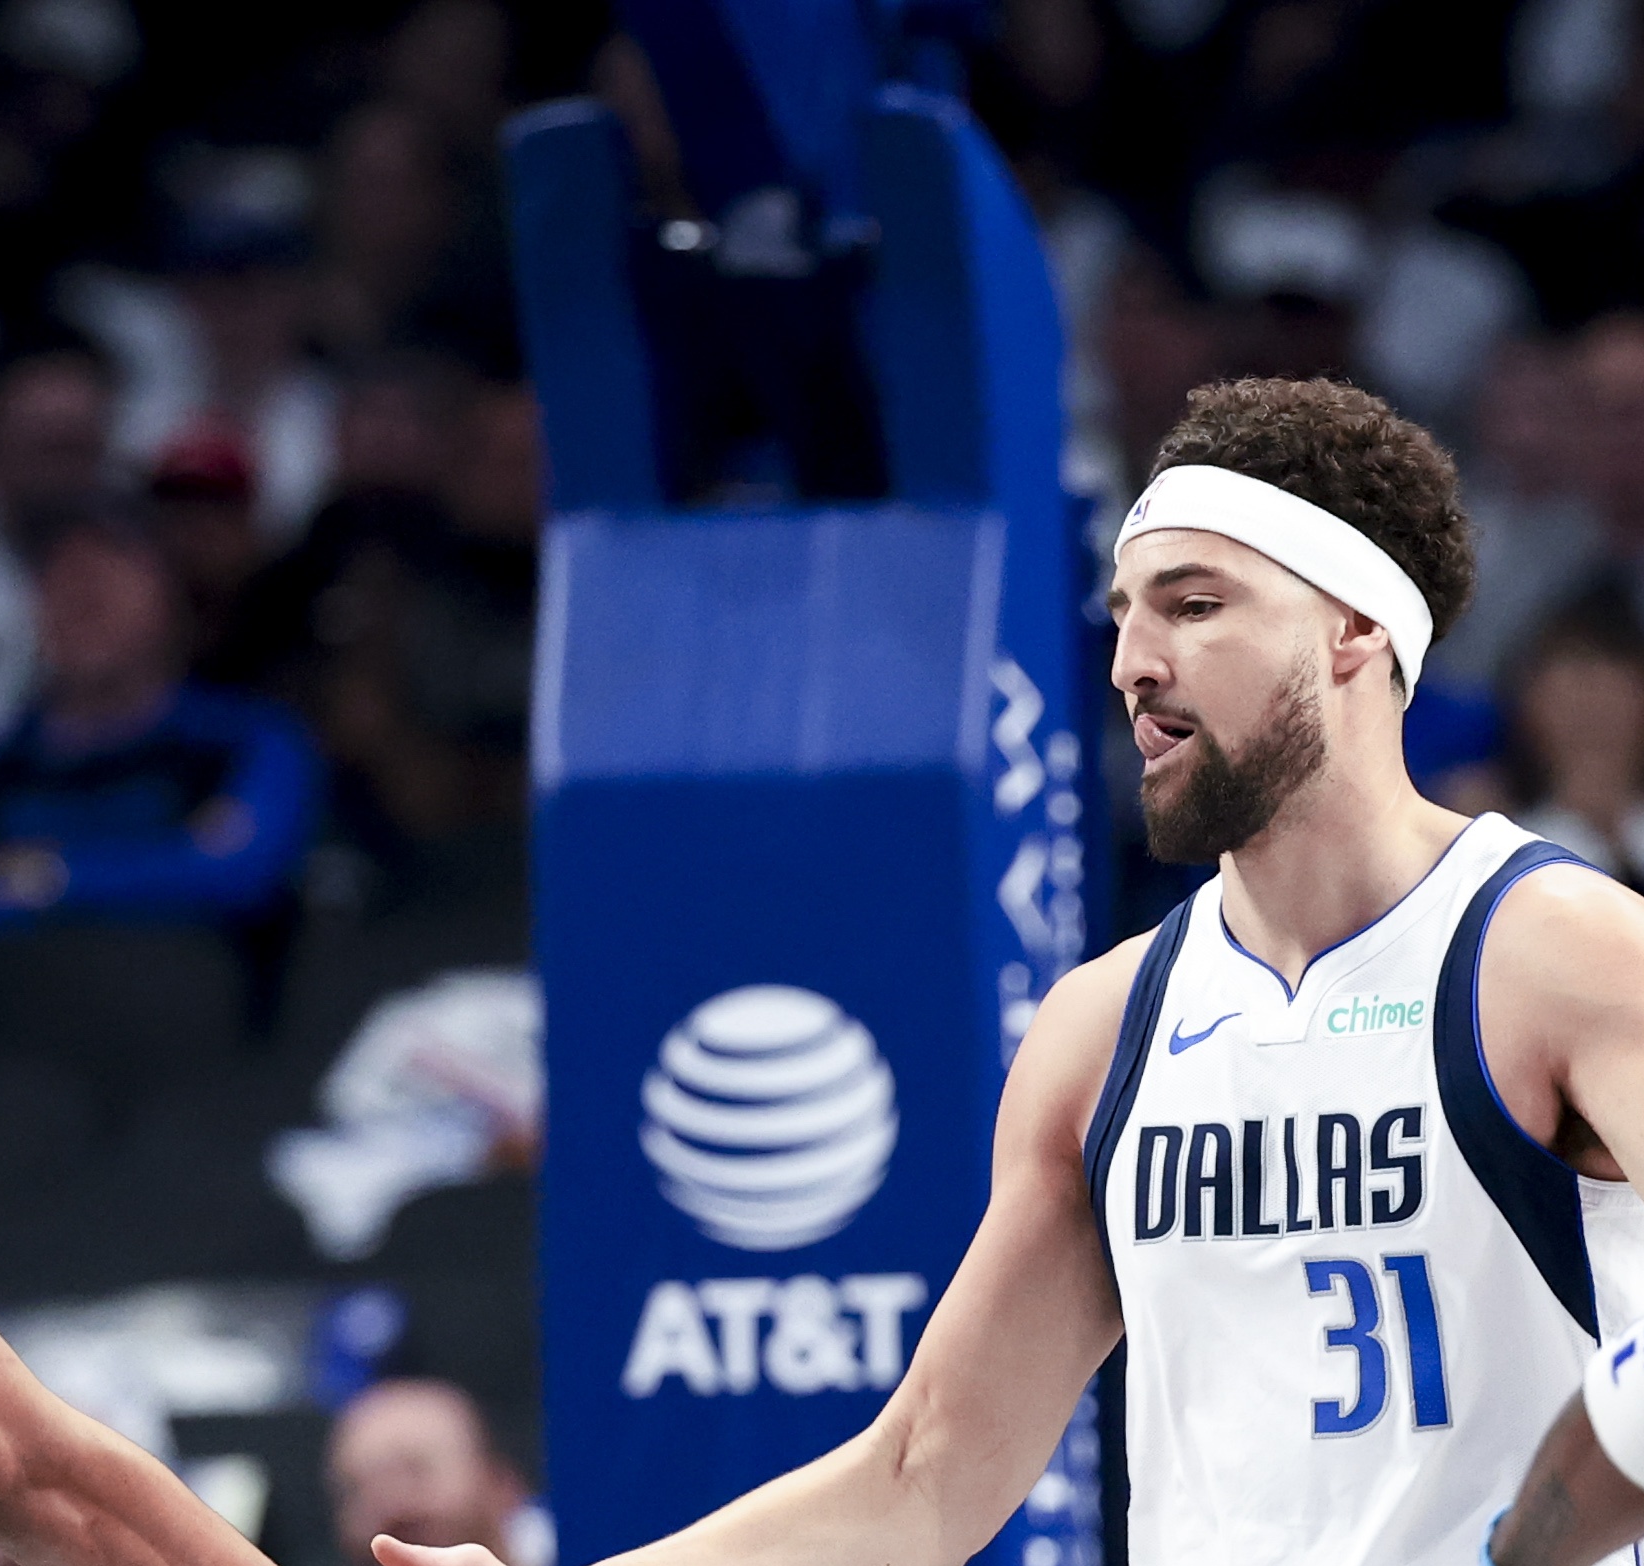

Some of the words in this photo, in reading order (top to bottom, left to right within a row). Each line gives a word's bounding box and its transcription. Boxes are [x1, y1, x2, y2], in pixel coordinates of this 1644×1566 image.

[1327, 994, 1425, 1035] chime
[1133, 1103, 1427, 1245] DALLAS
[620, 1272, 929, 1399] AT&T
[1301, 1250, 1453, 1440] 31
